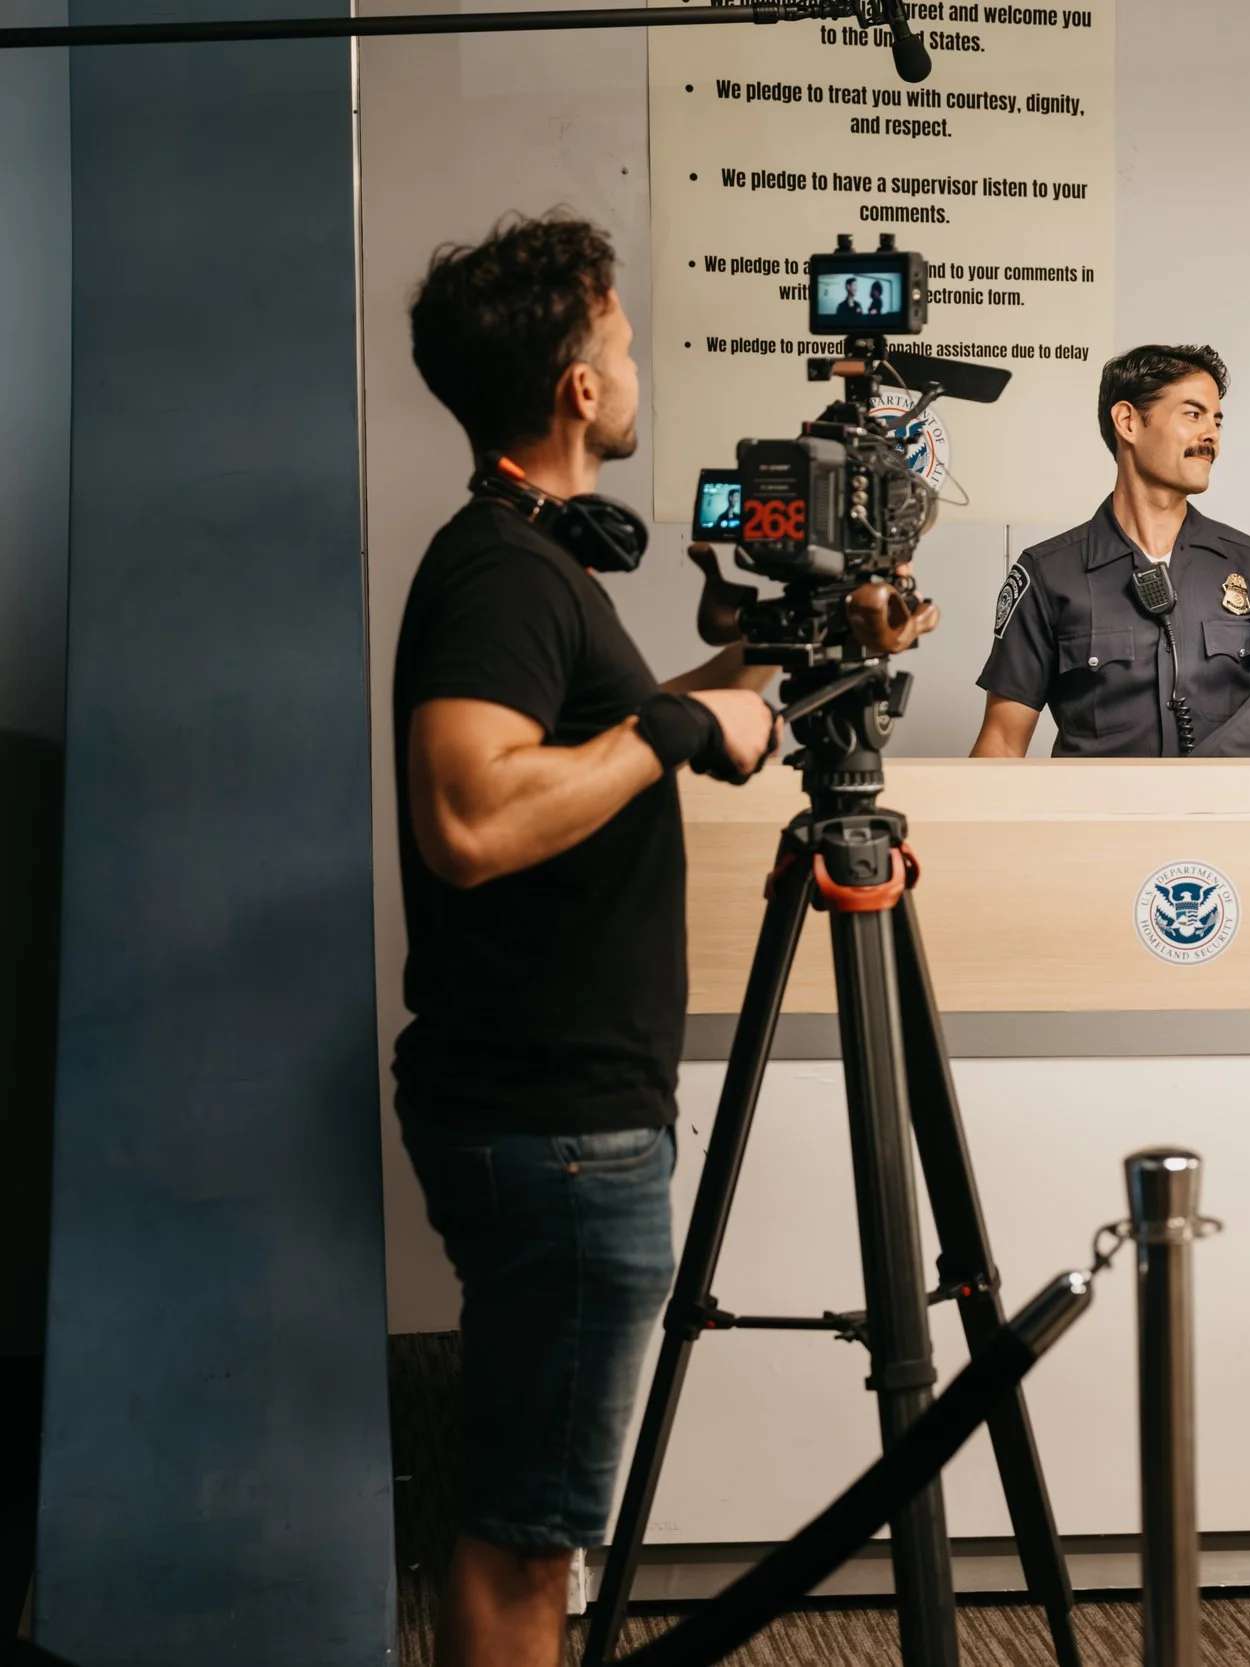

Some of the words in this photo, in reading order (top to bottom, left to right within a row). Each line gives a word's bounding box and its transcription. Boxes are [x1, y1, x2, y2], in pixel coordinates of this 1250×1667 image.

[948, 3, 979, 23] and
[983, 4, 1058, 26] welcome
[1062, 10, 1092, 29] you
[820, 24, 837, 45] to
[841, 25, 869, 46] the
[929, 30, 985, 53] States.
[715, 79, 742, 100] We
[746, 81, 803, 104] pledge
[806, 83, 824, 103] to
[828, 84, 868, 105] treat
[871, 89, 902, 108] you
[906, 87, 942, 109] with
[946, 91, 1022, 114] courtesy,
[1026, 93, 1085, 117] dignity,
[850, 115, 881, 135] and
[885, 118, 952, 139] respect.
[721, 167, 746, 188] We
[751, 169, 807, 192] pledge
[811, 171, 828, 191] to
[832, 172, 872, 193] have
[876, 176, 887, 193] a
[891, 175, 979, 197] supervisor
[982, 177, 1028, 198] listen
[1032, 179, 1048, 198] to
[1052, 182, 1088, 201] your
[859, 204, 950, 224] comments.
[704, 255, 727, 273] We
[730, 256, 780, 276] pledge
[784, 257, 799, 275] to
[950, 262, 964, 280] to
[968, 265, 1000, 282] your
[1004, 266, 1078, 282] comments
[1081, 265, 1094, 283] in
[925, 288, 984, 306] ectronic
[987, 288, 1025, 306] form.
[706, 336, 727, 353] We
[730, 337, 777, 355] pledge
[779, 338, 794, 354] to
[935, 342, 1008, 358] assistance
[1011, 343, 1035, 359] due
[1038, 344, 1051, 359] to
[1055, 344, 1089, 362] delay
[932, 428, 946, 444] OF
[1156, 866, 1225, 889] DEPARTMENT
[1222, 891, 1233, 904] OF
[1140, 919, 1189, 960] HOMELAND
[1194, 917, 1233, 959] SECURITY
